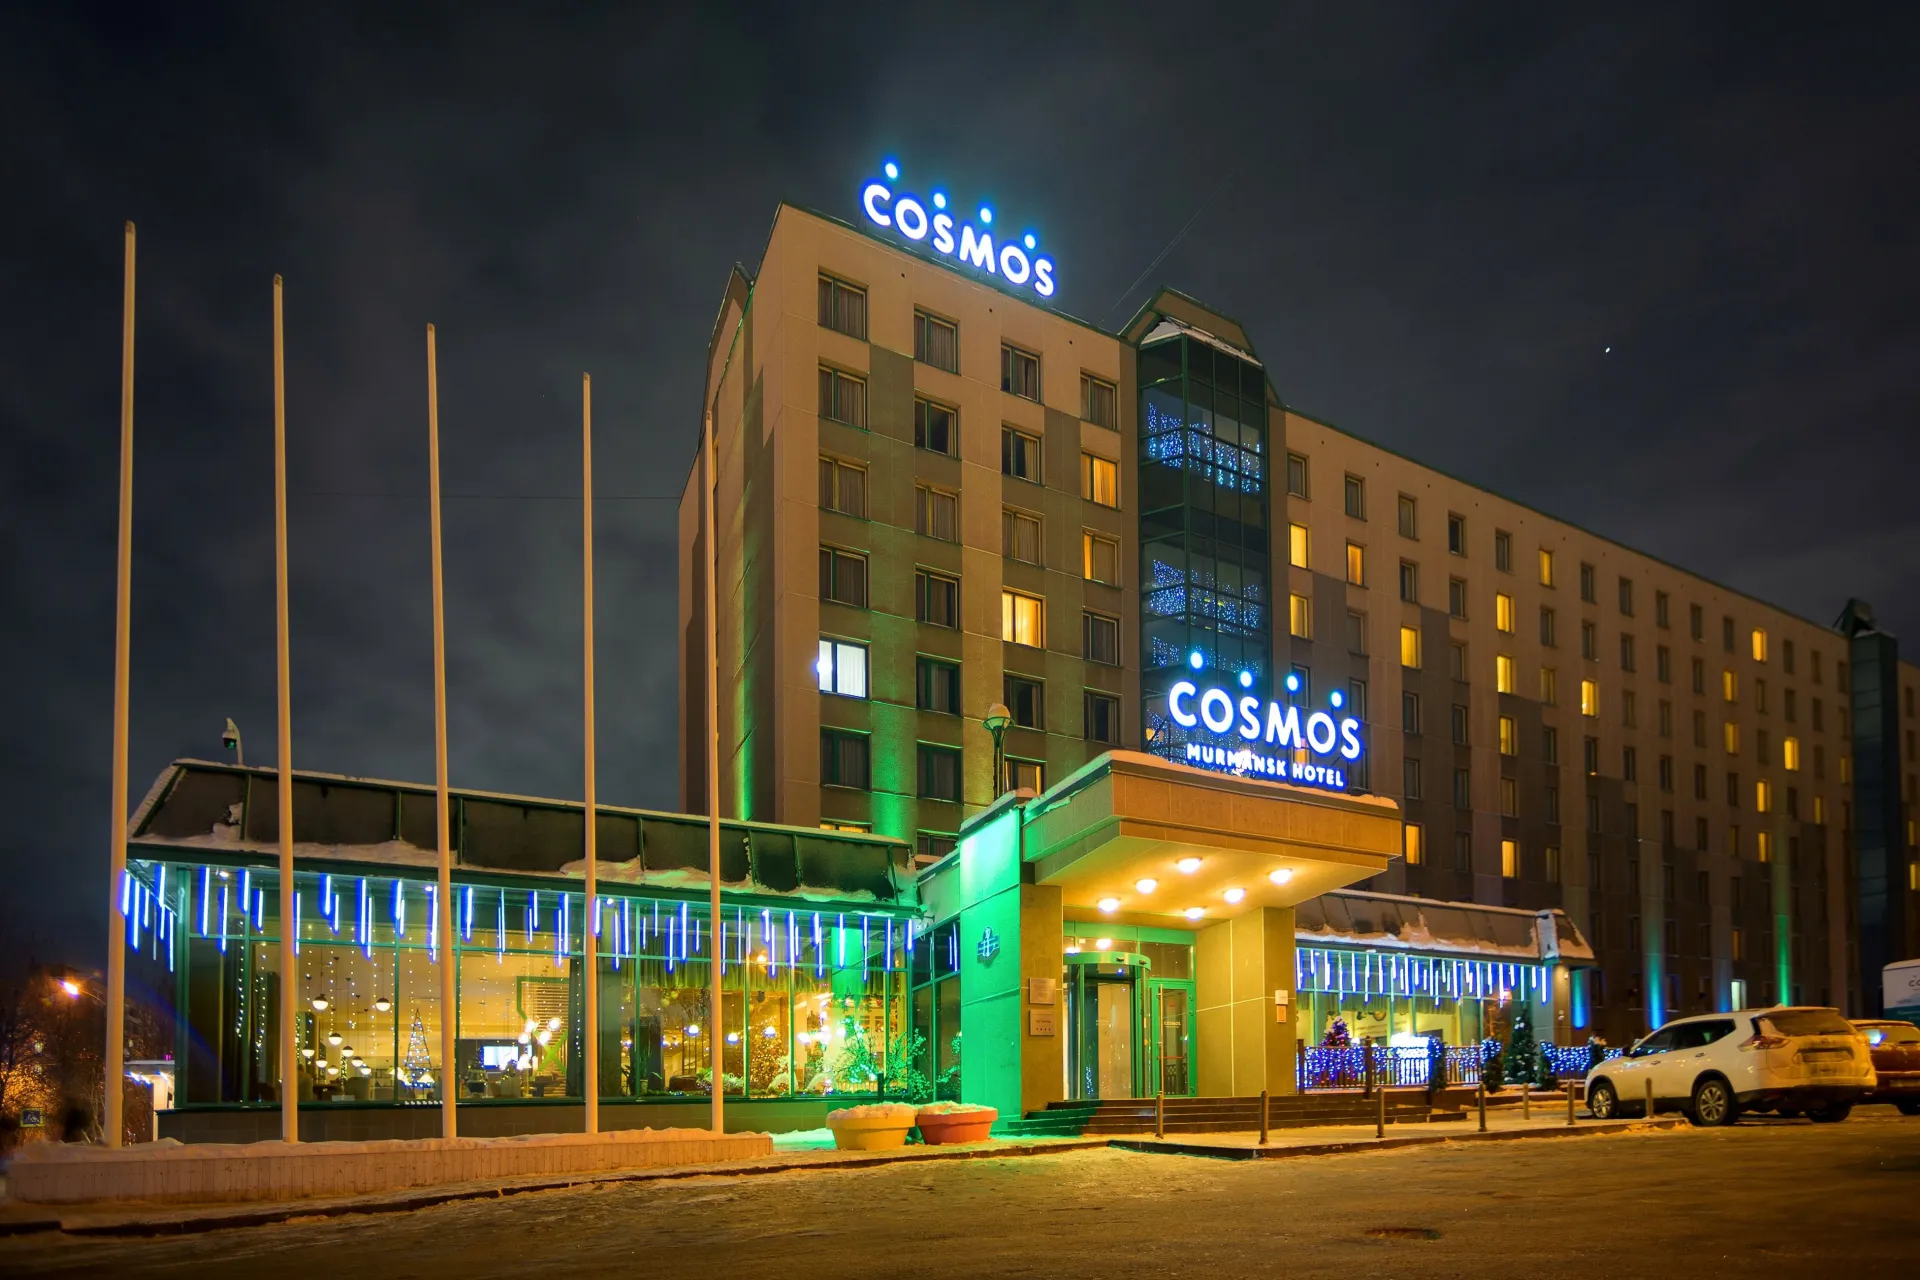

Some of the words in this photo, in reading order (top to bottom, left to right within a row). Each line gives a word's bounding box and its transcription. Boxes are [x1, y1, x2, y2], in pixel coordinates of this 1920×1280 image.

[863, 184, 1053, 296] COSMOS
[1168, 681, 1360, 759] COSMOS
[1293, 763, 1344, 787] HOTEL
